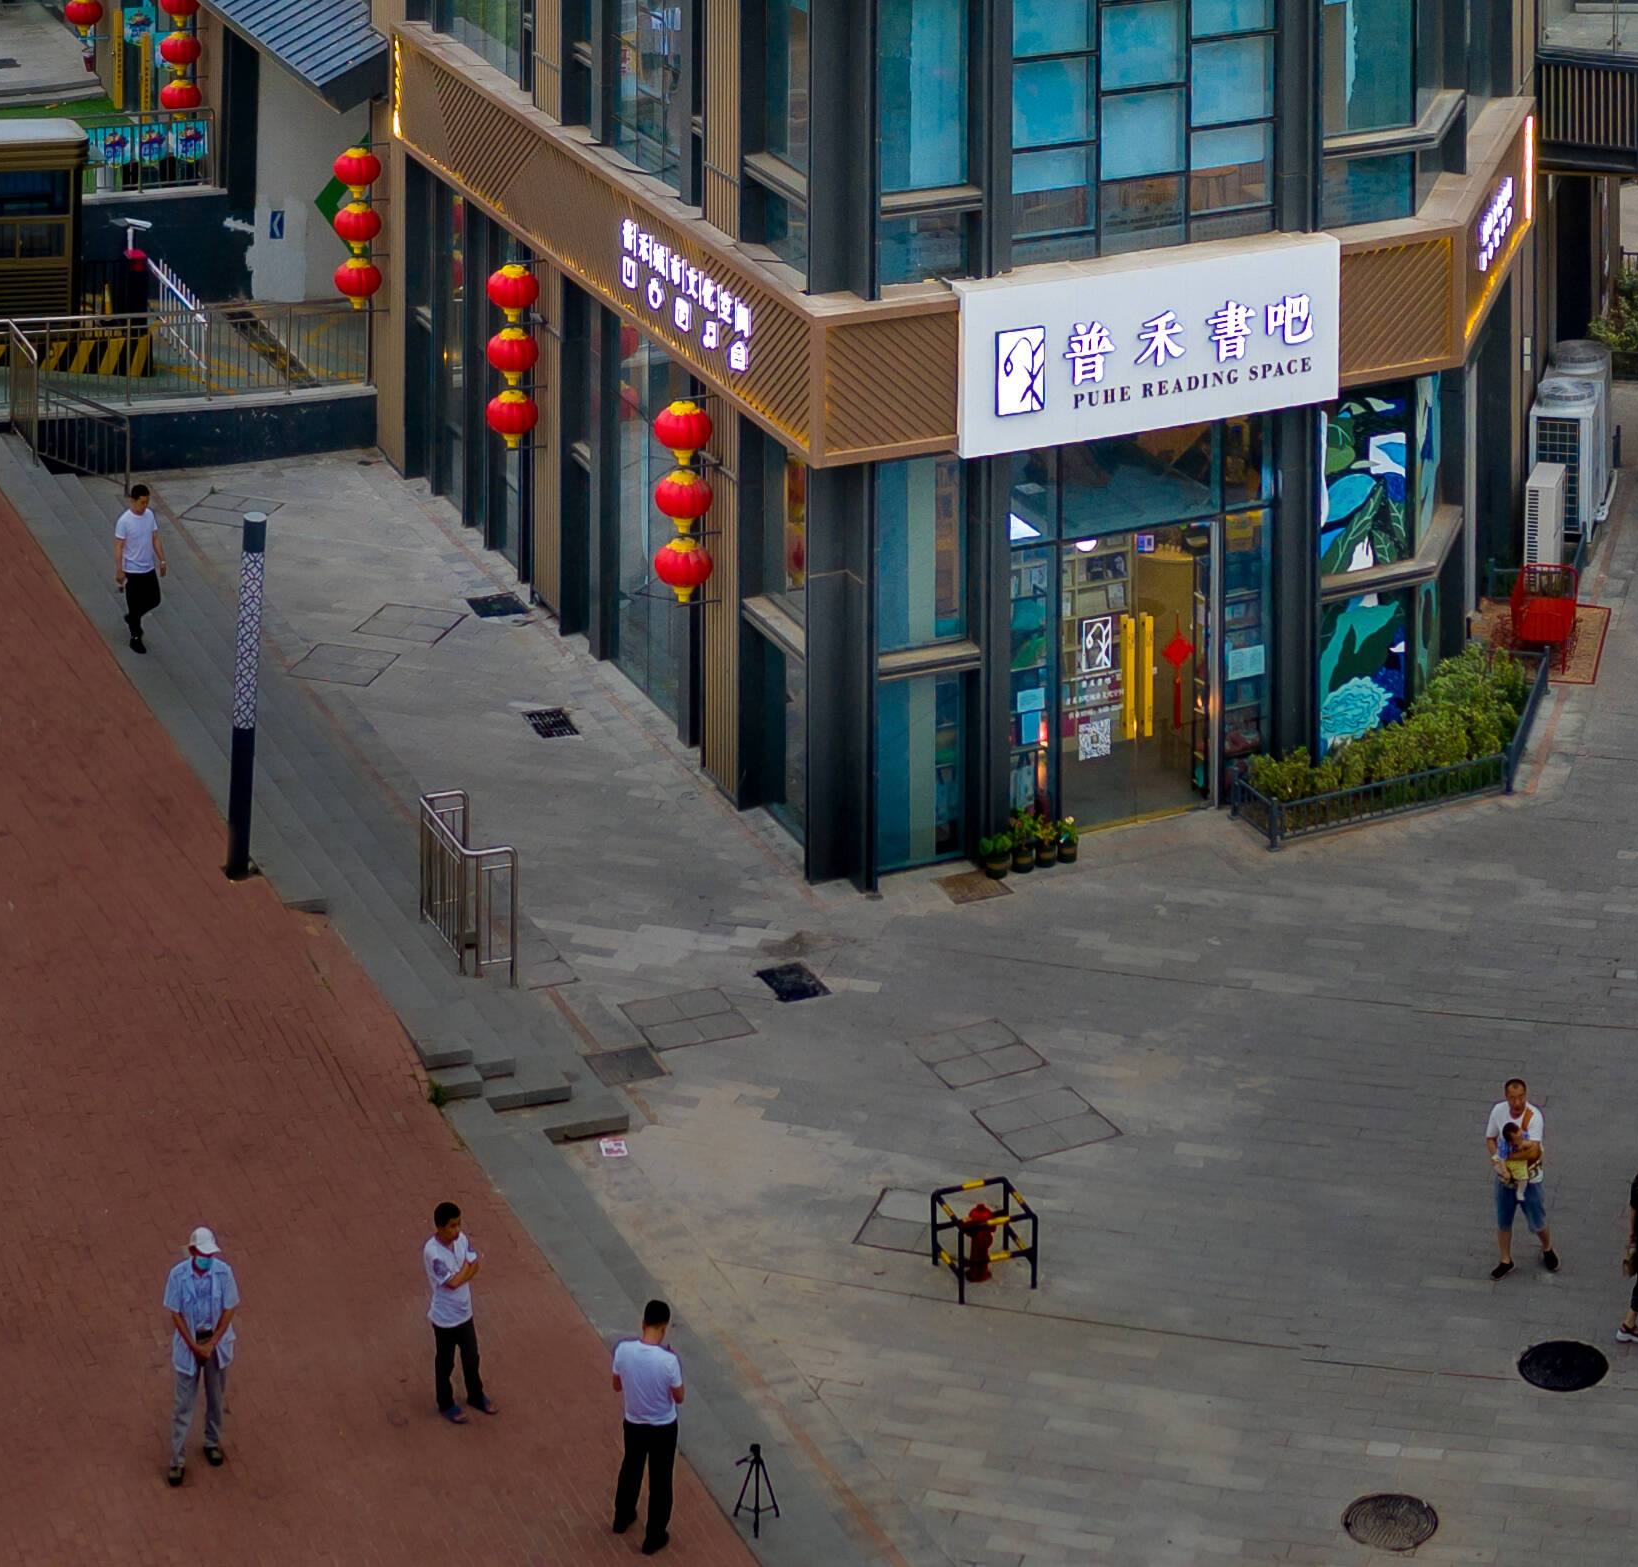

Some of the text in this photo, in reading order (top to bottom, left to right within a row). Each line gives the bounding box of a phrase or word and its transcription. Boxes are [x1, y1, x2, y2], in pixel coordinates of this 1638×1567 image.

[1064, 293, 1315, 387] 普禾書吧
[1073, 356, 1313, 410] PUHE READING SPACE
